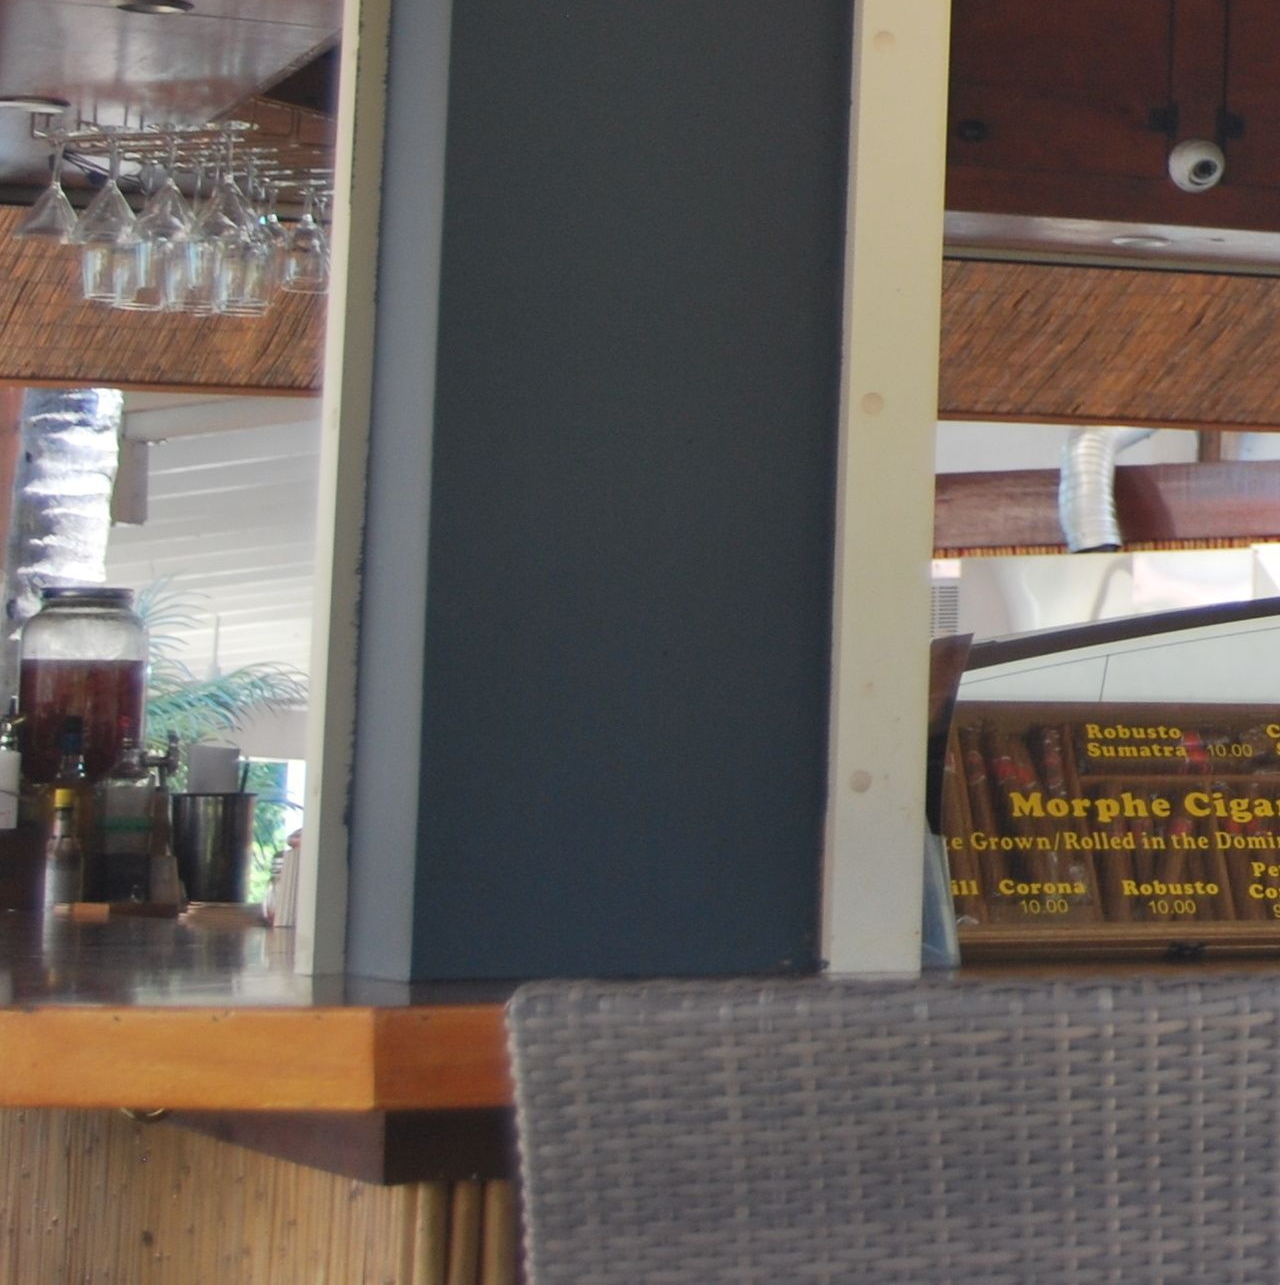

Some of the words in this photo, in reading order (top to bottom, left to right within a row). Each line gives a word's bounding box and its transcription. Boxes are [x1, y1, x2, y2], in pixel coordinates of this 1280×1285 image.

[1086, 724, 1183, 739] Robusto
[1087, 742, 1188, 758] Sumatra
[1207, 743, 1253, 758] 10.00
[1009, 791, 1171, 823] Morphe
[1142, 831, 1166, 850] in
[1171, 831, 1209, 850] the
[999, 879, 1086, 895] Corona
[1121, 879, 1219, 895] Robusto
[1019, 898, 1069, 914] 10.00
[1148, 899, 1197, 915] 10.00
